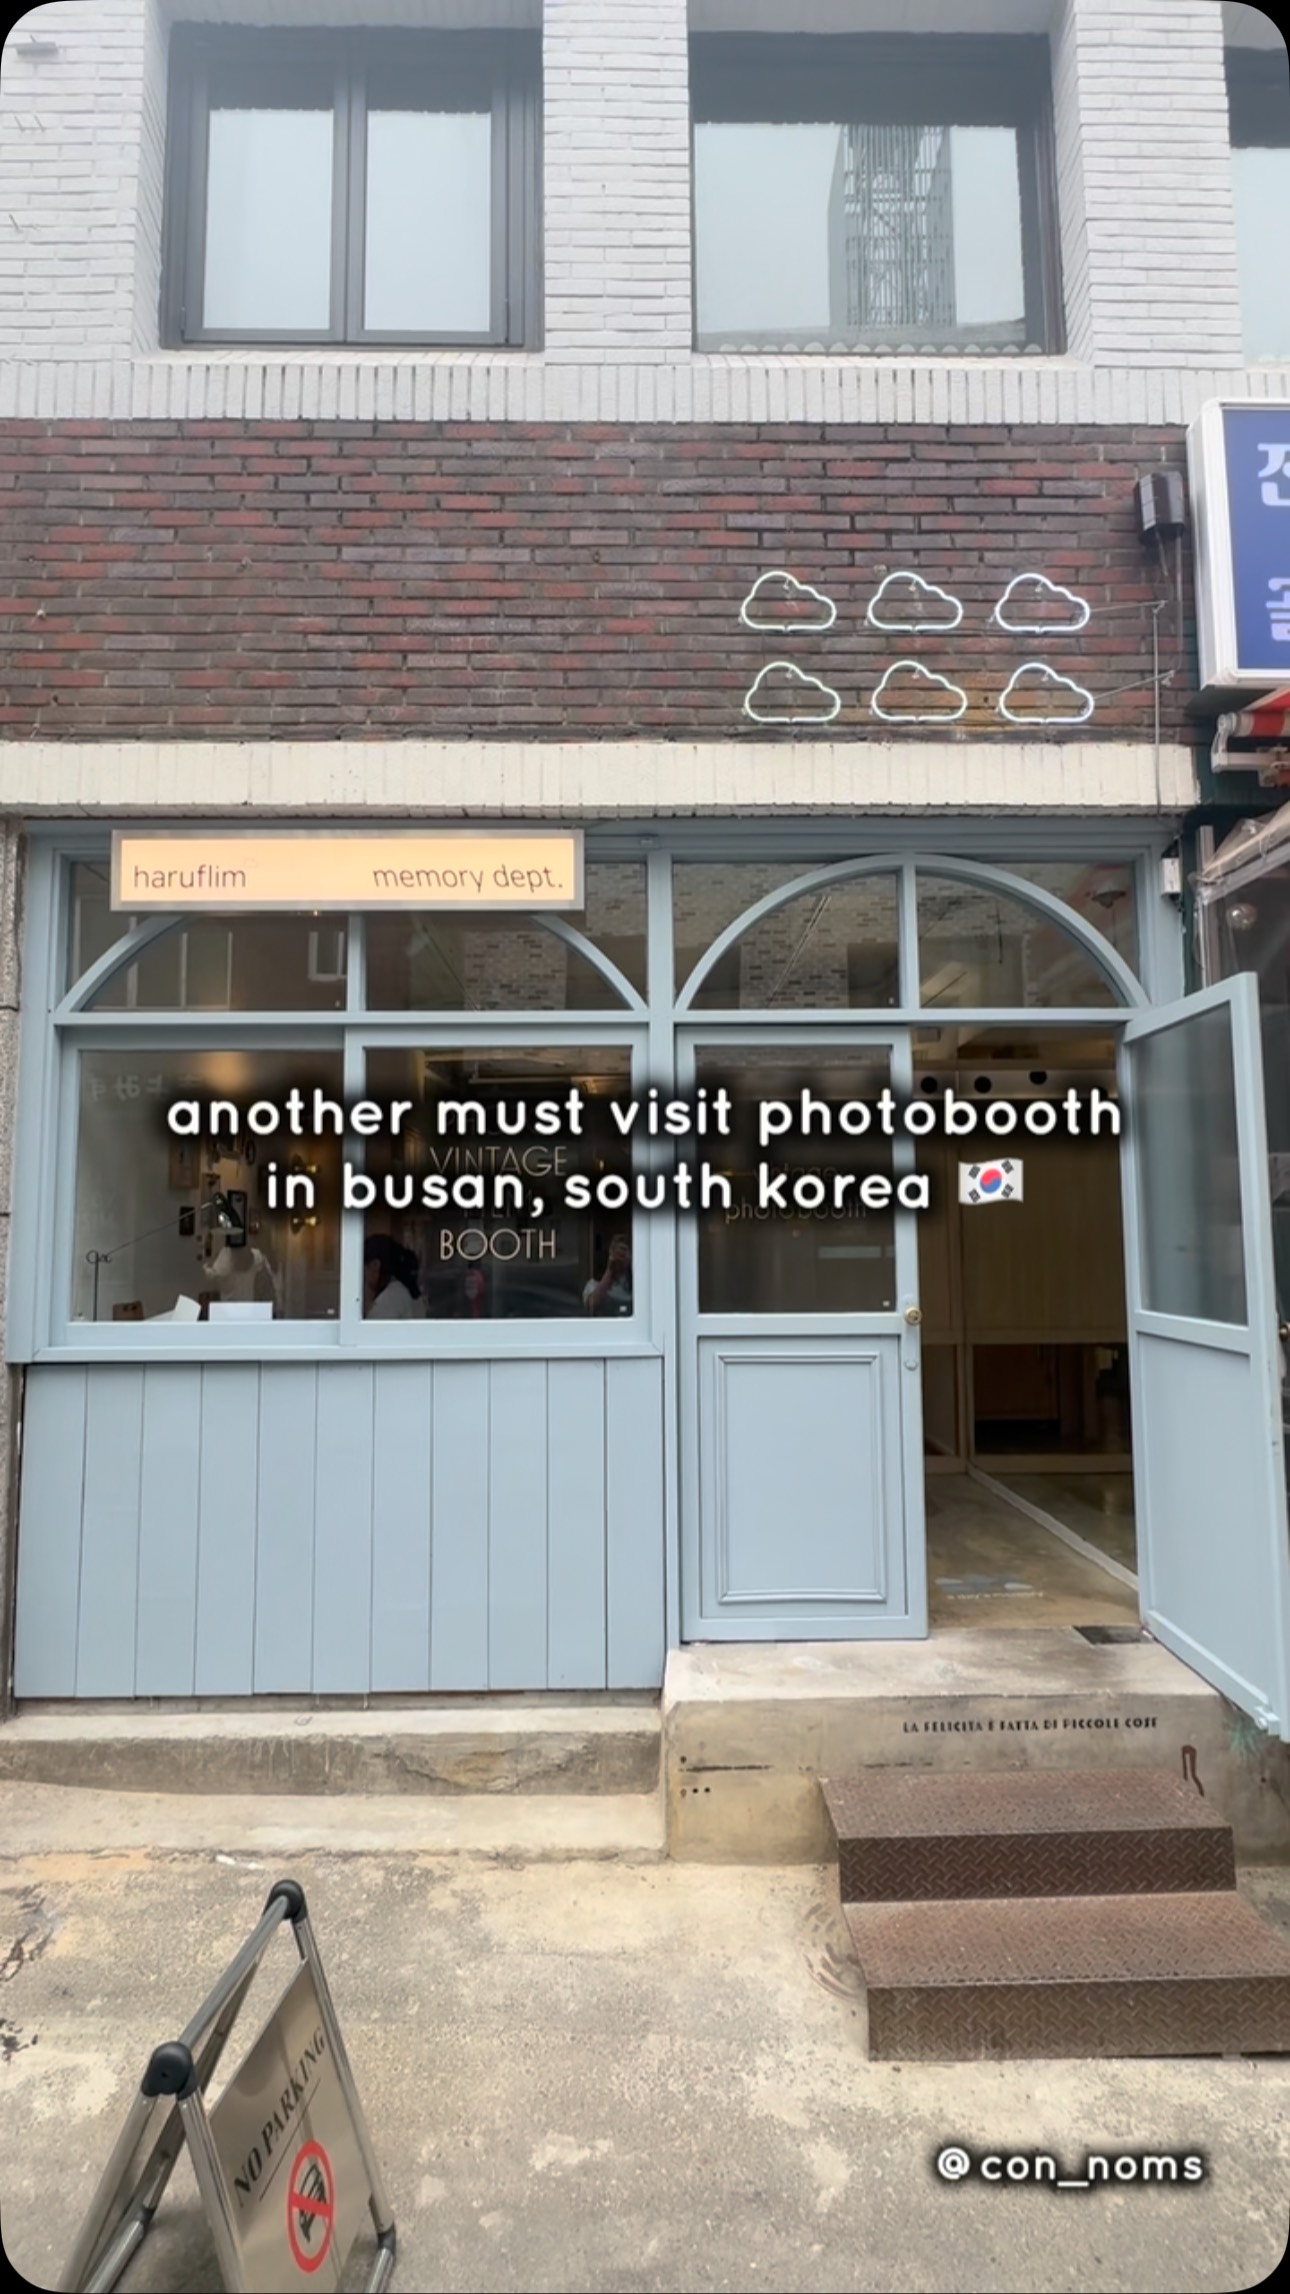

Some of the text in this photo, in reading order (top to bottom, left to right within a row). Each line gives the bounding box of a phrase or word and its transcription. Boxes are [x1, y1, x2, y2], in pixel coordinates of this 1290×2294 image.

[133, 864, 564, 894] haruflim memory dept.
[429, 1145, 568, 1178] VINTAGE
[439, 1228, 557, 1261] BOOTH
[903, 1721, 919, 1733] LA
[1043, 1718, 1058, 1730] DI
[233, 2026, 326, 2208] NO PARKING
